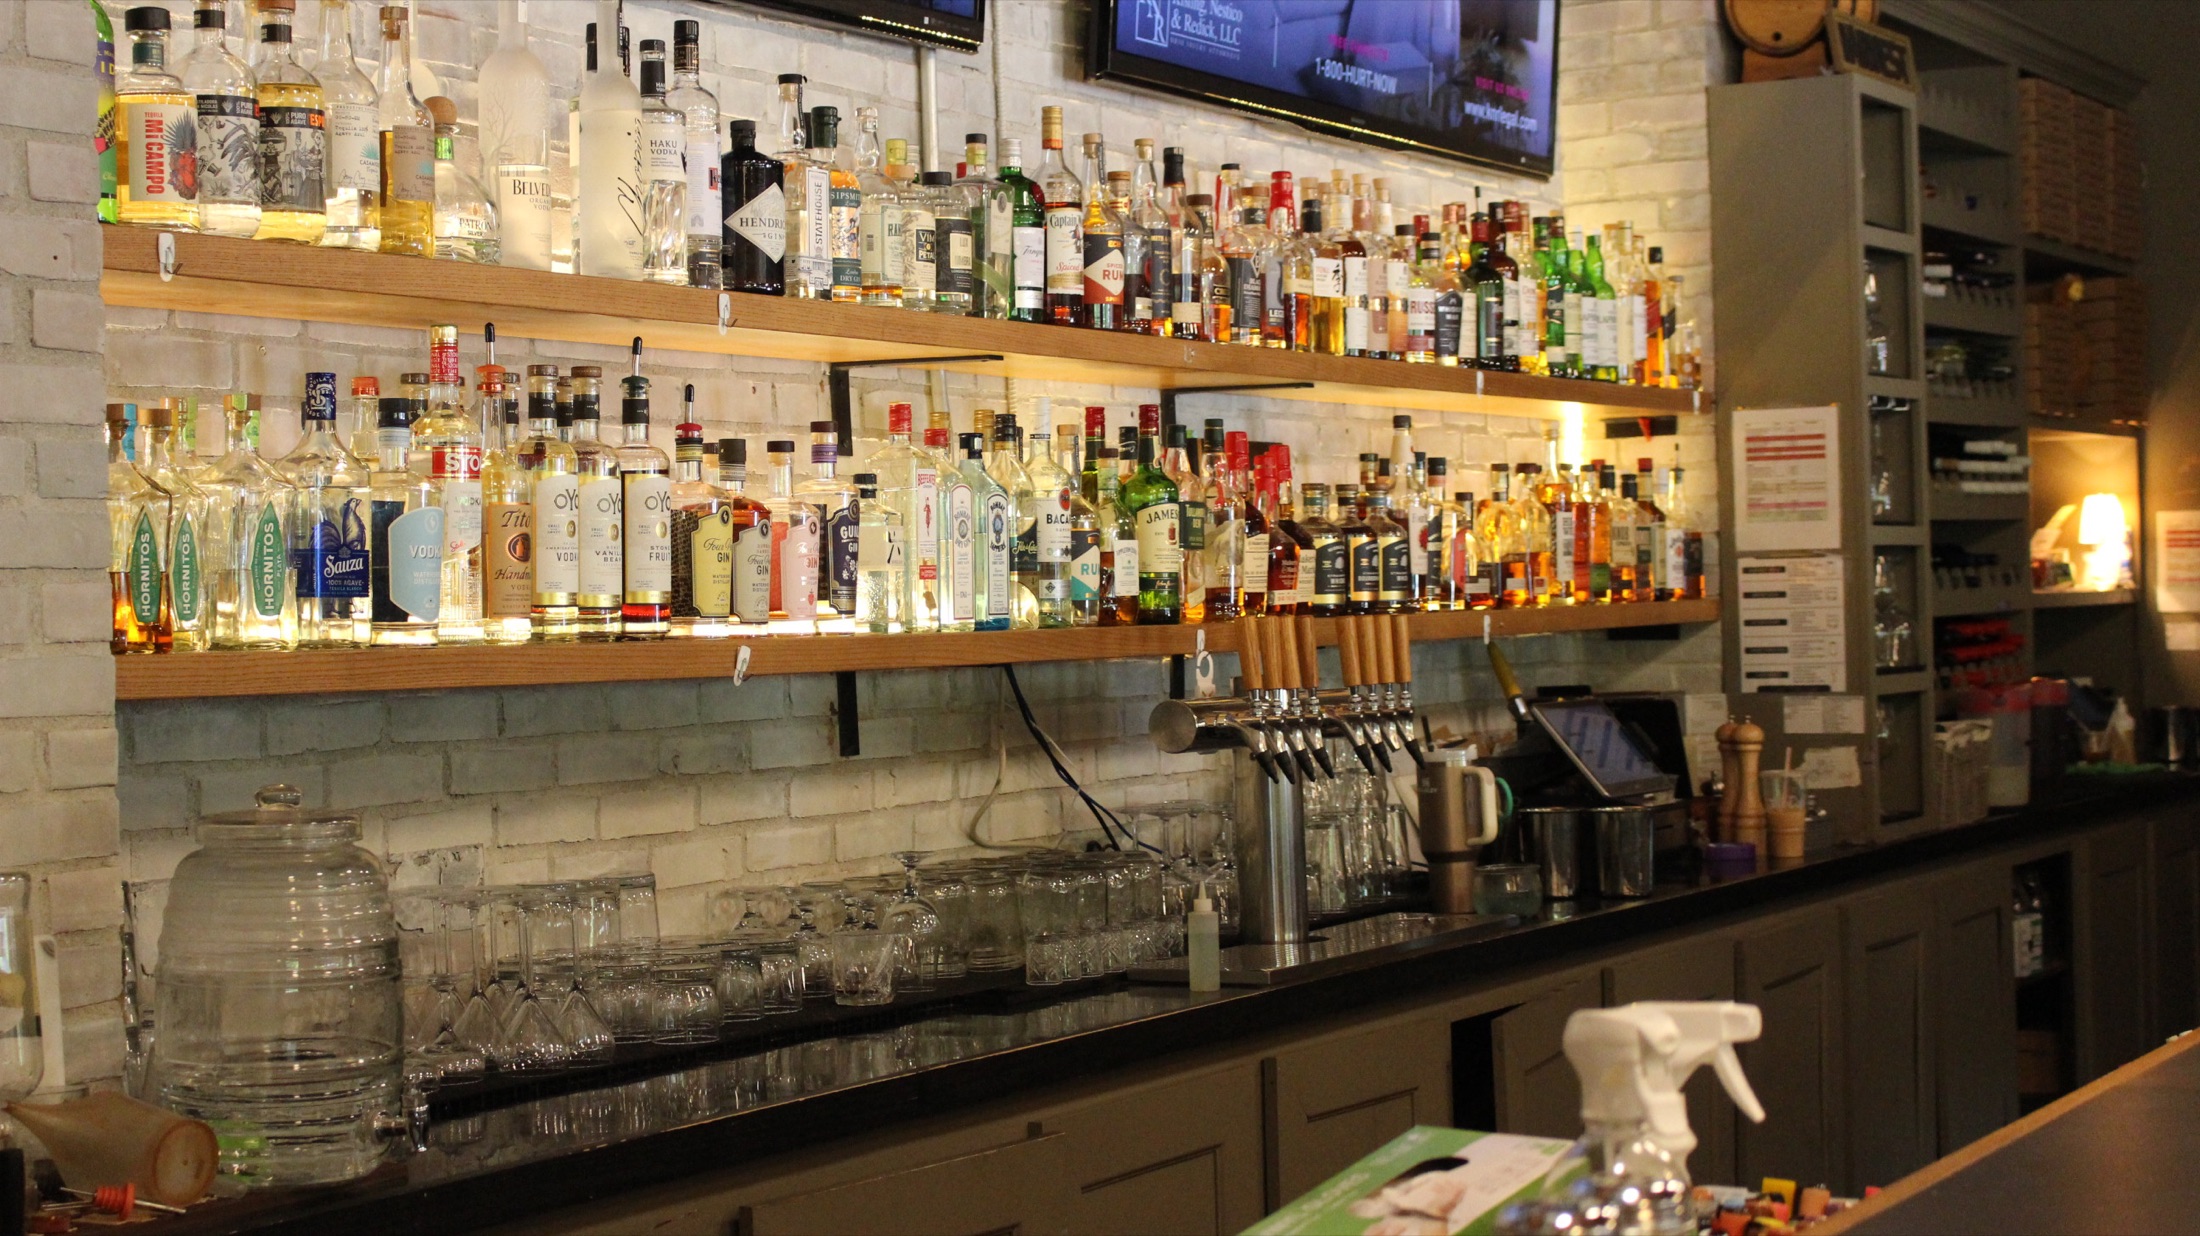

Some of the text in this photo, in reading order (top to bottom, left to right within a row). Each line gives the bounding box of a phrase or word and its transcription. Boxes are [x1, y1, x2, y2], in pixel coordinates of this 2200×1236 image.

[1171, 8, 1241, 45] & Redick, LLC
[1315, 57, 1398, 94] 1-800-HURT-NOW
[650, 139, 678, 148] HAKU
[650, 148, 678, 156] VODKA
[145, 142, 165, 194] CAMPO
[815, 182, 823, 245] STATEHOUSE
[1050, 214, 1077, 228] Captain
[140, 533, 151, 616] HORNITOS
[182, 533, 191, 614] HORNITOS
[263, 522, 275, 609] HORNITOS
[324, 555, 364, 578] Sauza
[717, 552, 730, 563] GIN
[756, 565, 769, 575] GIN
